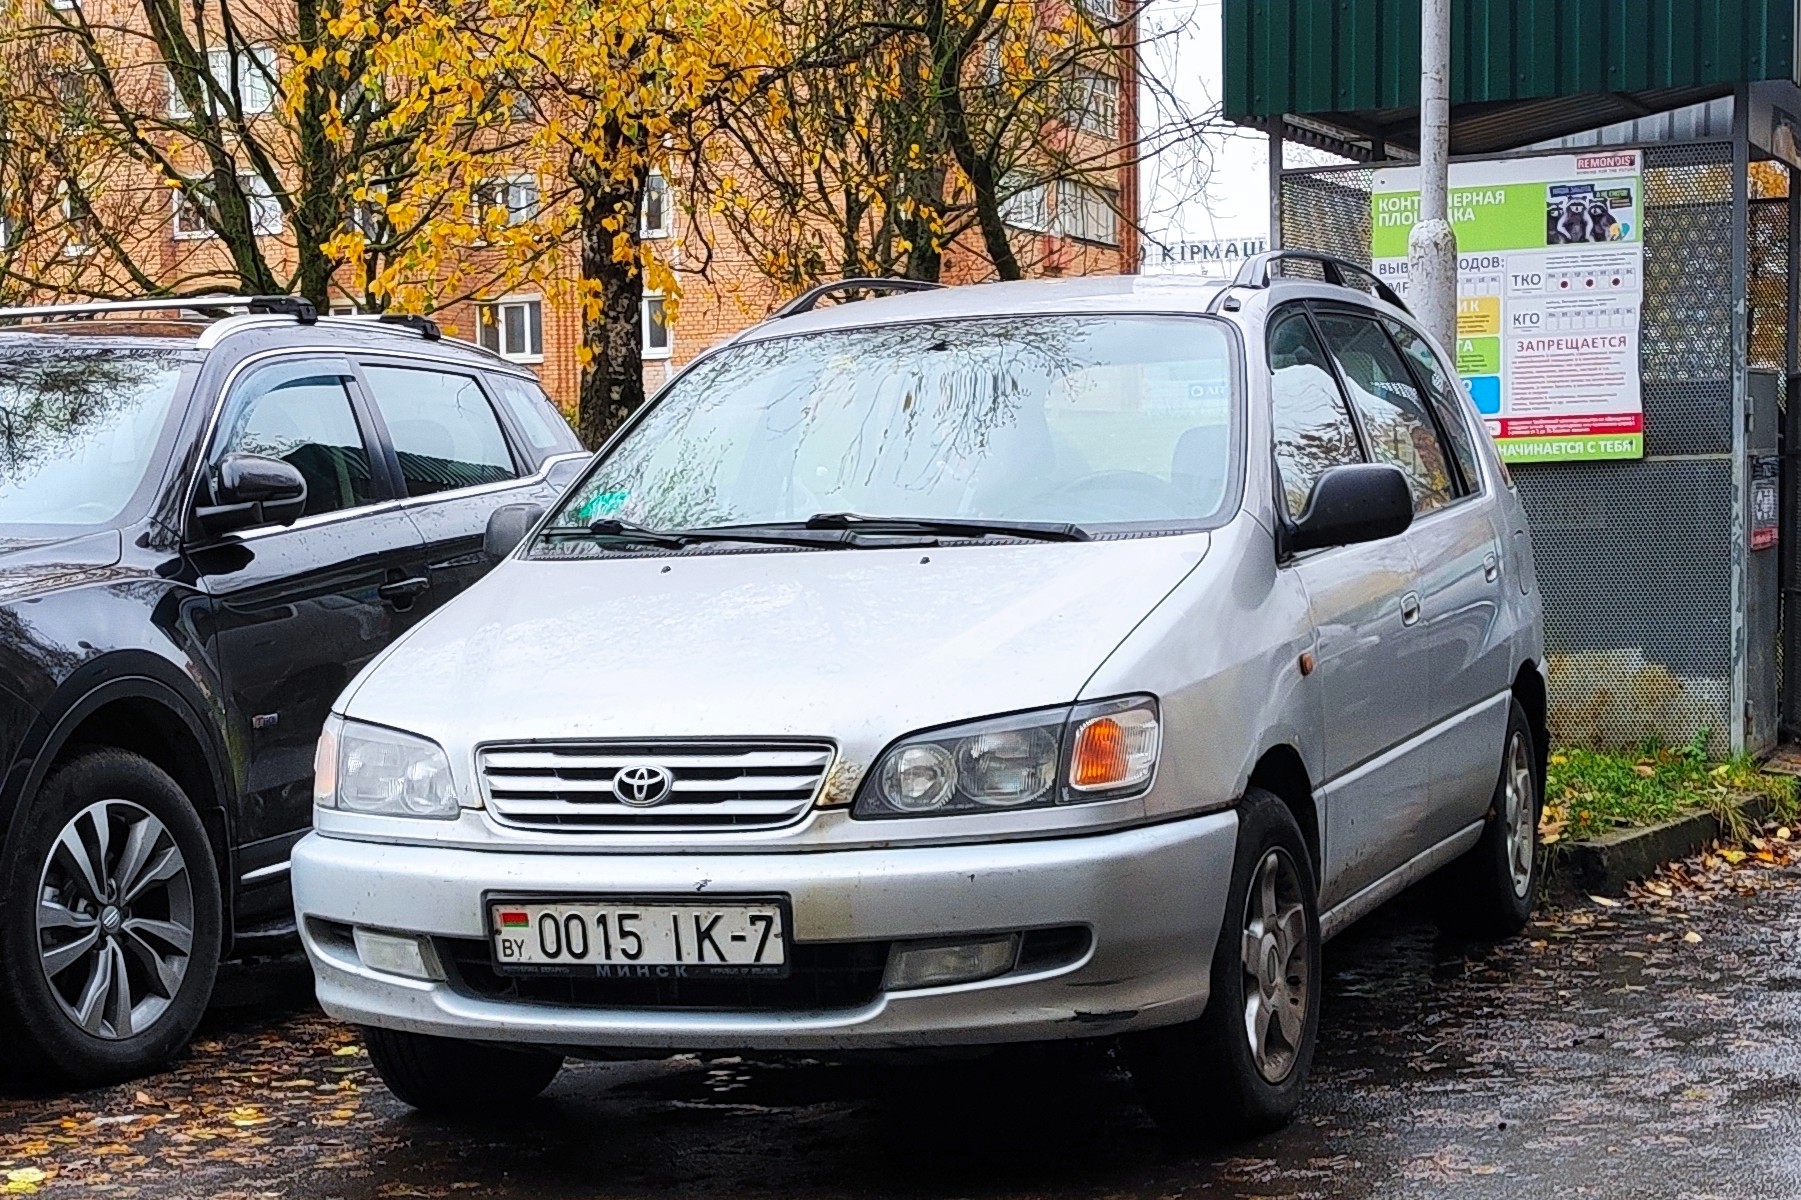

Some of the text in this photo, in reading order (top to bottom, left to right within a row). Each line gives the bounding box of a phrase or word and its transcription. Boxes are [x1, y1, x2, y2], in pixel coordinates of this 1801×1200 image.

[1577, 155, 1631, 169] REMONDIS
[1511, 273, 1541, 287] ТКО
[1513, 312, 1540, 326] КГО
[1517, 336, 1627, 352] ЗАПРЕЩАЕТСЯ
[1587, 441, 1596, 453] С
[1598, 438, 1636, 453] ТЕБЯ!
[537, 912, 774, 963] 0015 IK-7
[502, 938, 525, 958] BY
[596, 965, 688, 978] МИНСК
